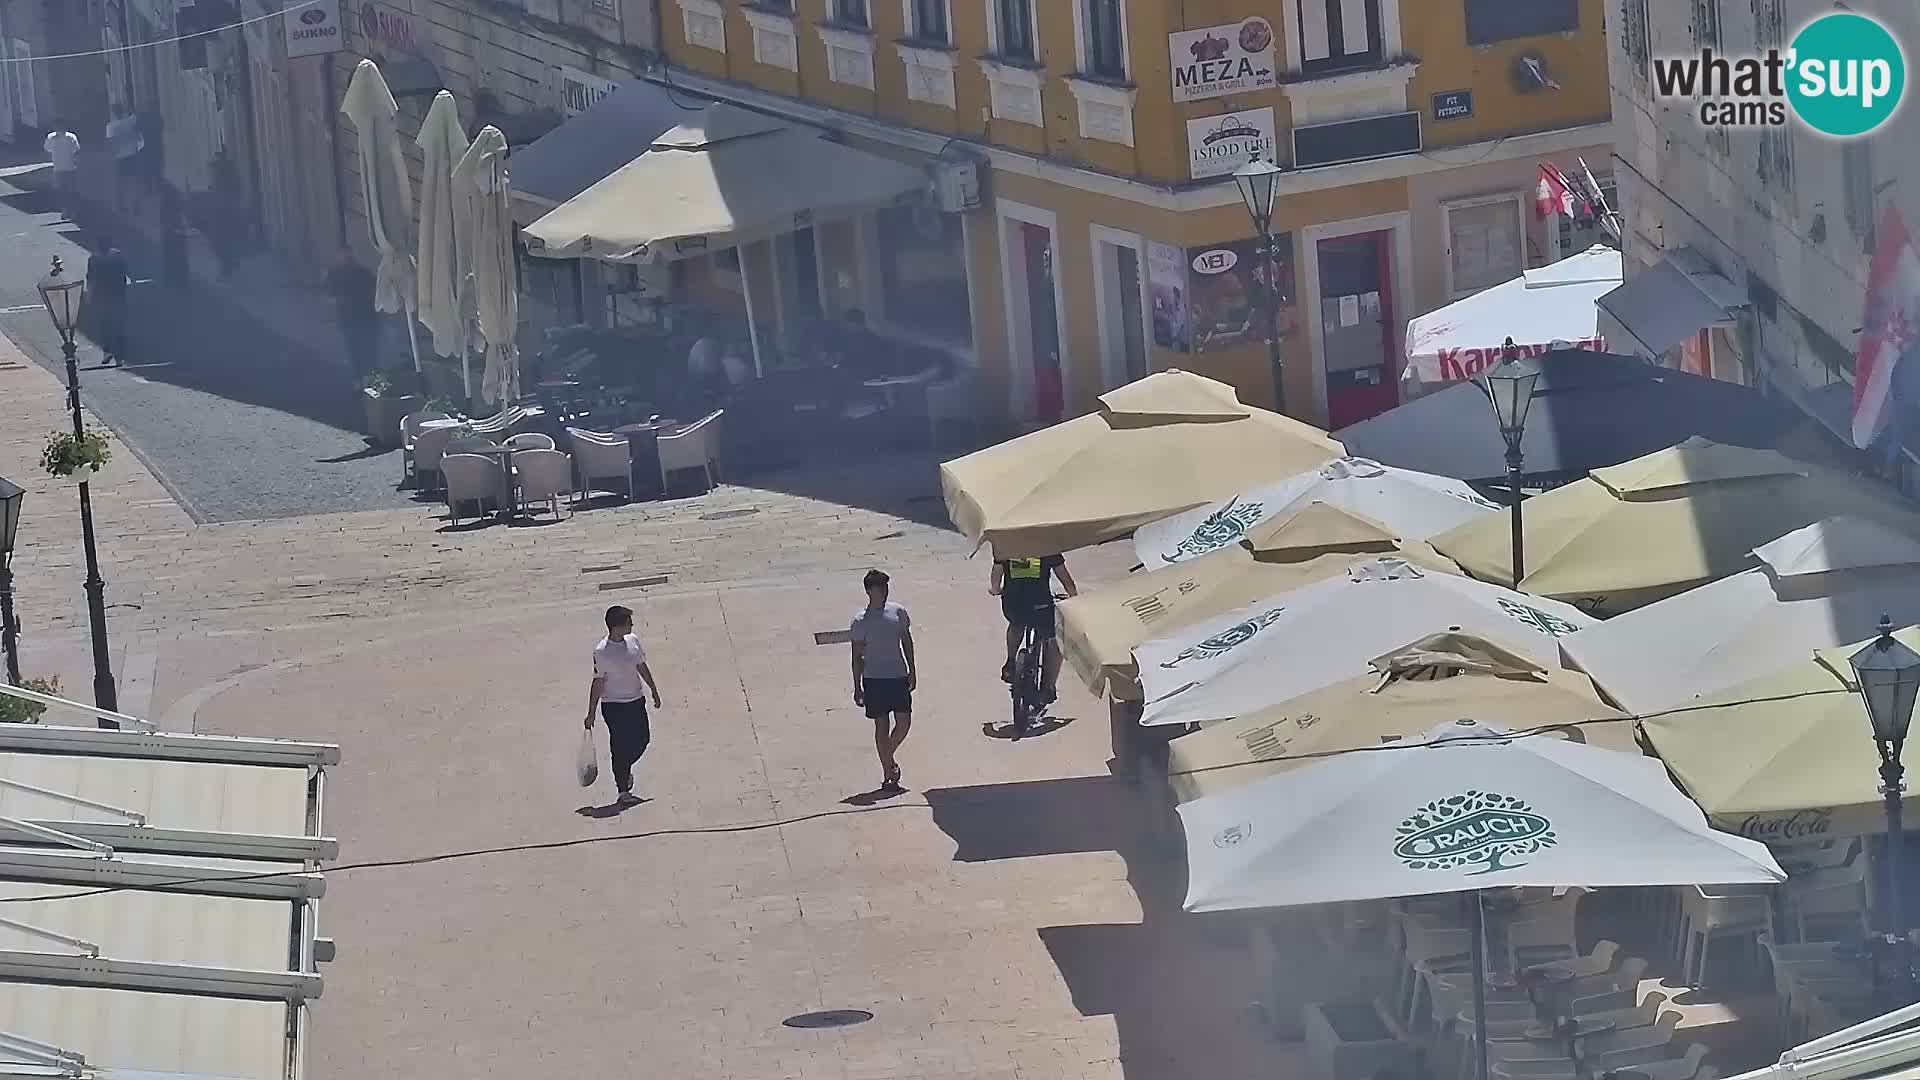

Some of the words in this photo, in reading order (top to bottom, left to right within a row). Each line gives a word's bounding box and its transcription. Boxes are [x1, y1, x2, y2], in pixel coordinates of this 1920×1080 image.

[292, 26, 337, 40] SUKNO
[1175, 57, 1254, 87] MEZA
[1184, 84, 1217, 95] PIZZERIA
[1225, 79, 1245, 89] GRILL
[1193, 143, 1240, 161] ISPOD
[1434, 817, 1532, 849] RAUCH
